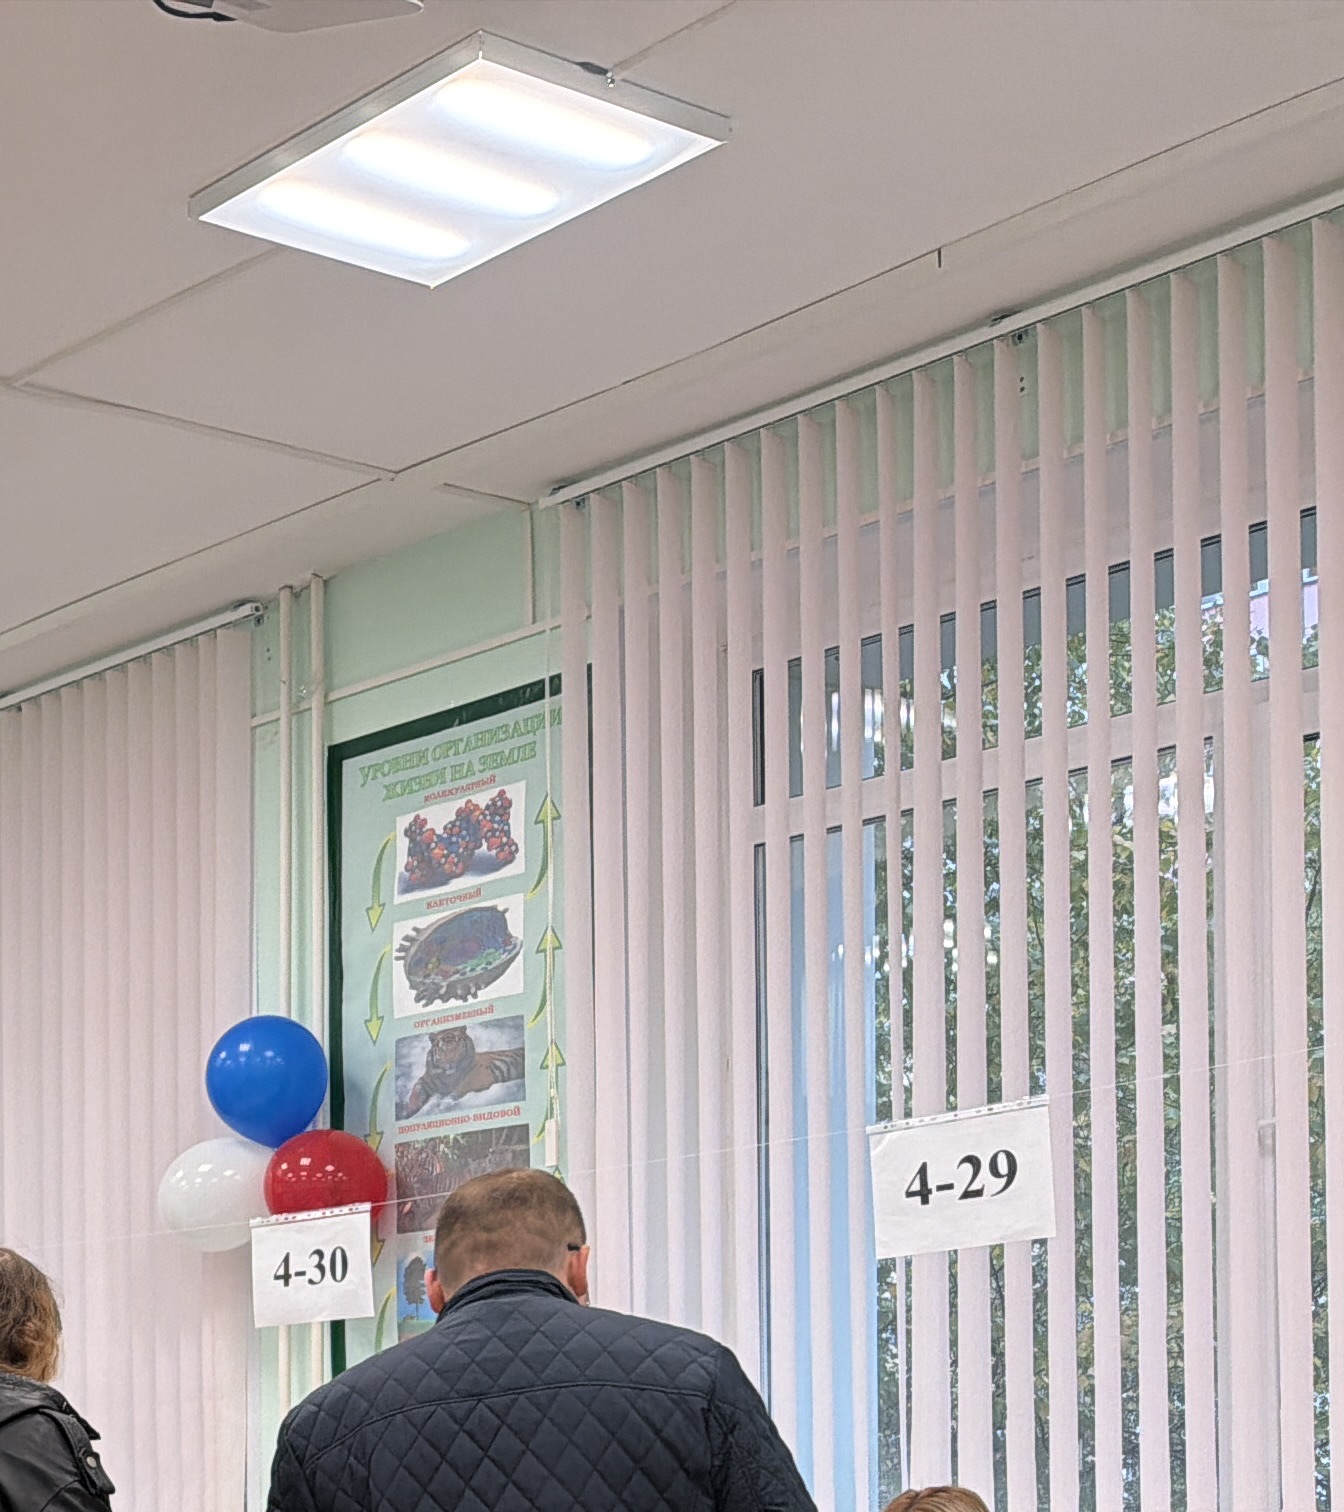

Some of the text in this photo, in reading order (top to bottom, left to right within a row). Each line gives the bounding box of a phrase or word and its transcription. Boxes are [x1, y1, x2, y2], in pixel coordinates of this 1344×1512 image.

[359, 748, 429, 788] УРОВНИ
[383, 740, 537, 802] ЖИЗНИ НА ЗЕМЛЕ
[905, 1149, 1018, 1206] 4-29
[273, 1246, 348, 1288] 4-30
